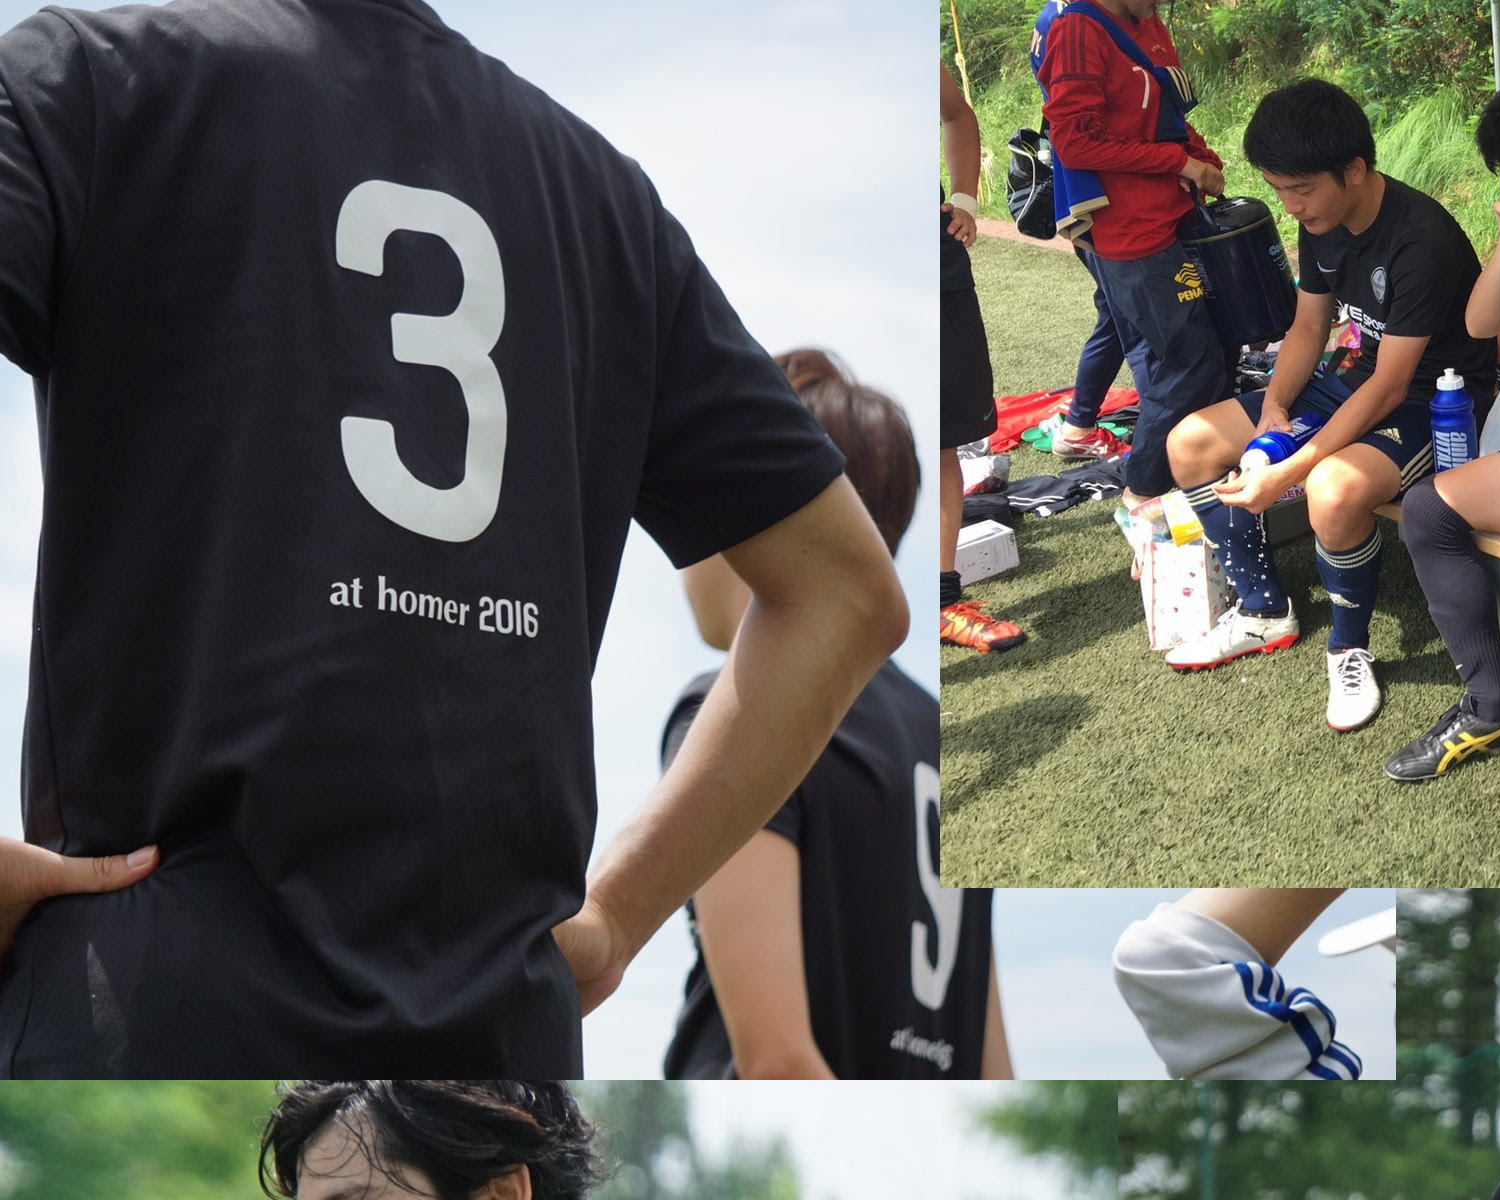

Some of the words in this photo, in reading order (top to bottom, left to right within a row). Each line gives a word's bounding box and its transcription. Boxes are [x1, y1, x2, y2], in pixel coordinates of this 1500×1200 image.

[335, 179, 507, 543] 3
[329, 577, 363, 609] at
[377, 575, 470, 626] homer
[478, 595, 540, 638] 2016
